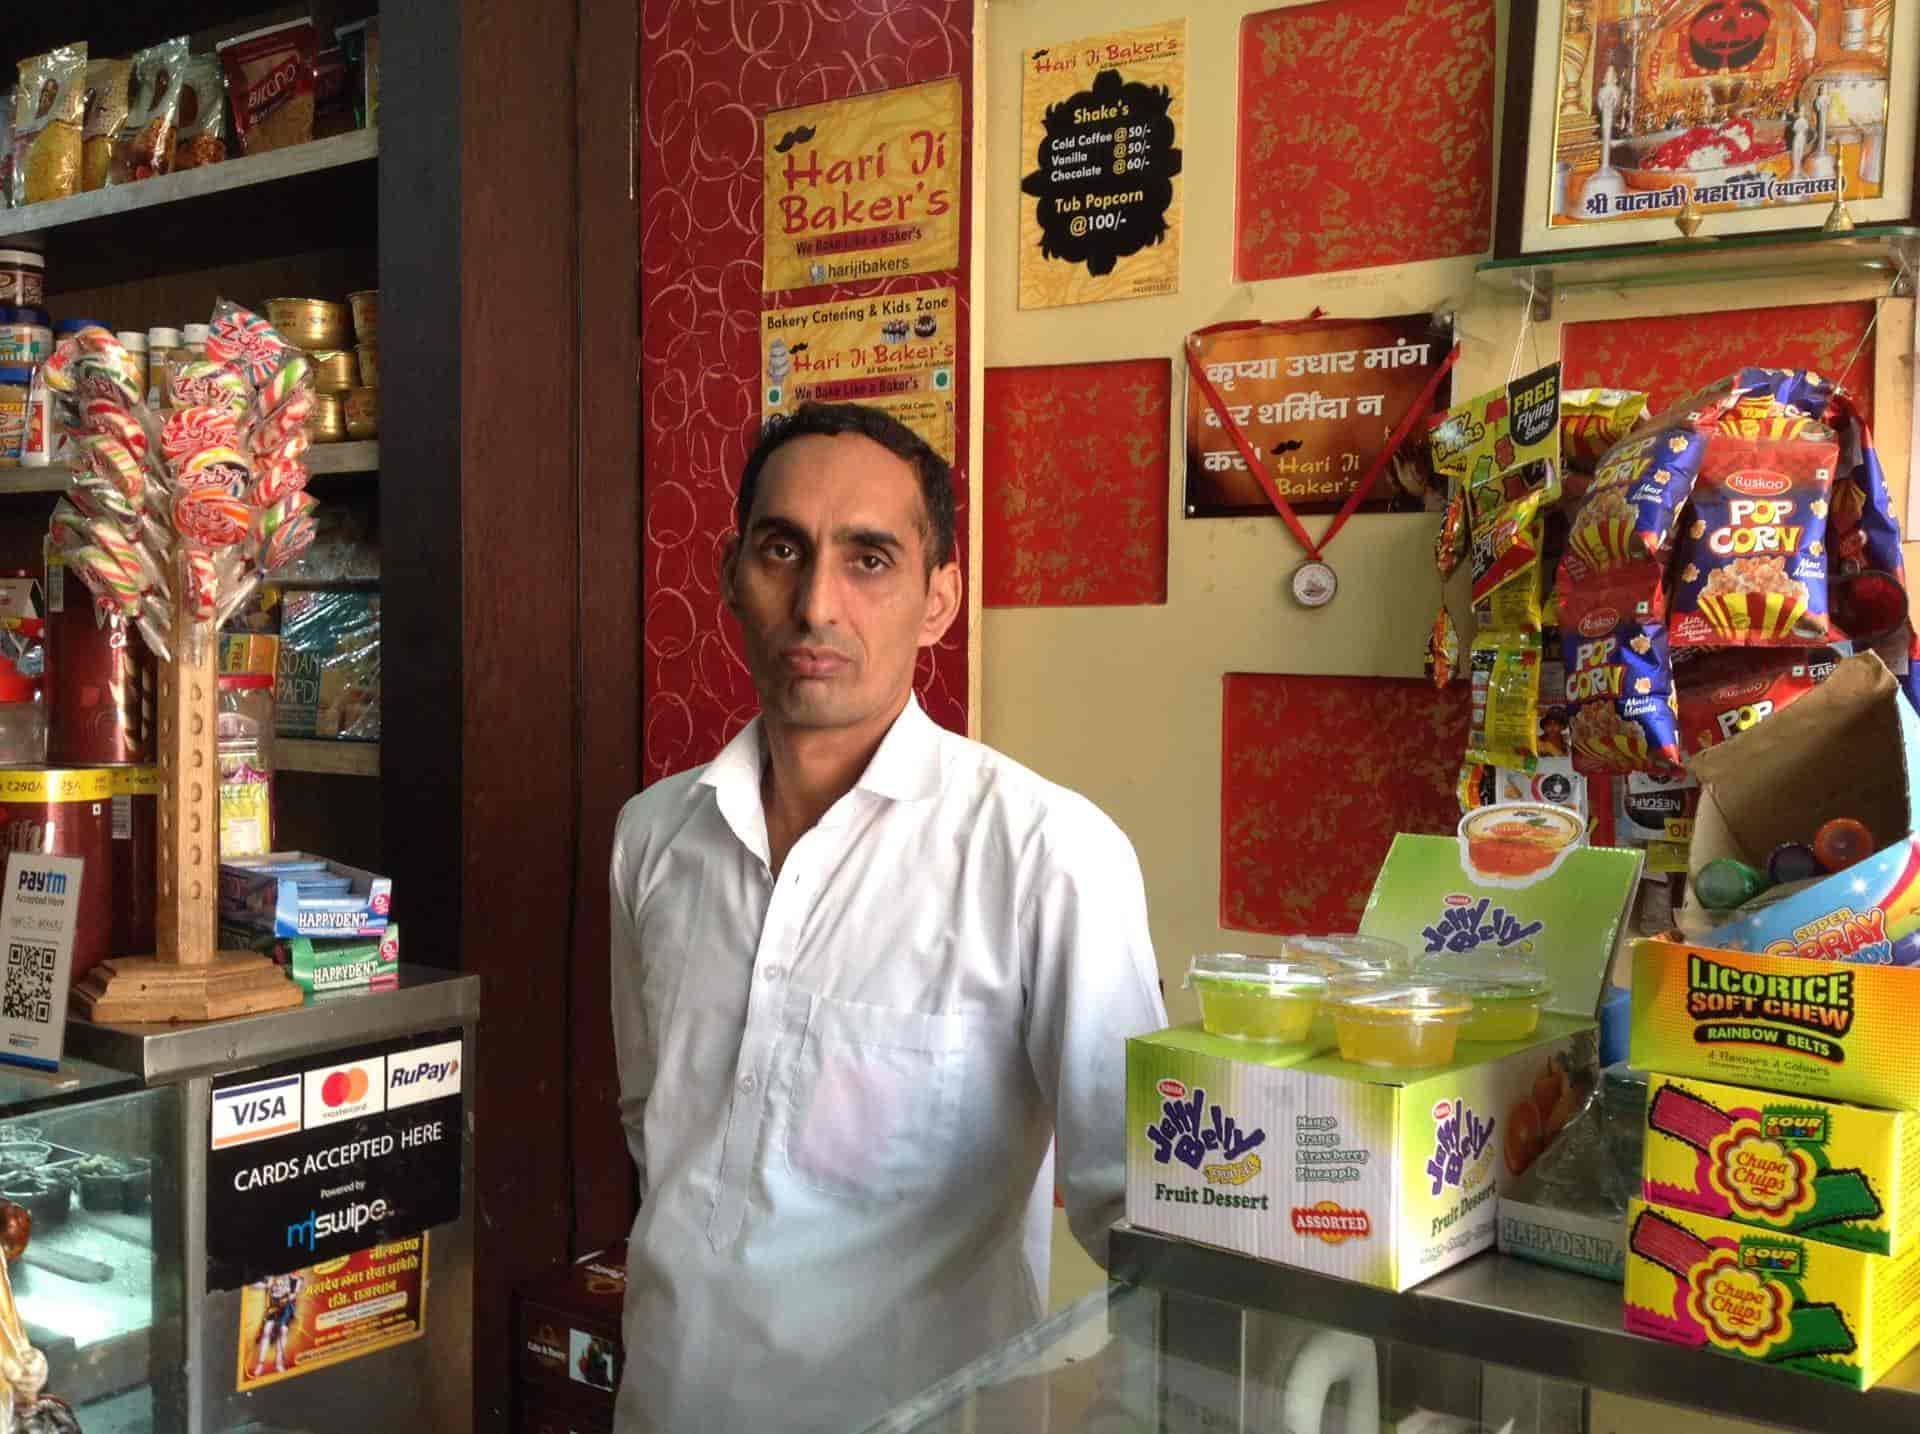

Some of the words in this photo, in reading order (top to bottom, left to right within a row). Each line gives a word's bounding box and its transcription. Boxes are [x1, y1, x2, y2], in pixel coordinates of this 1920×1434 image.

[1036, 56, 1077, 73] Hari
[1086, 49, 1100, 67] Ji
[1106, 35, 1177, 60] Baker's
[1073, 99, 1129, 124] Shake's
[1051, 136, 1075, 151] Cold
[1078, 131, 1112, 146] Coffee
[783, 142, 887, 190] Hari
[910, 130, 947, 175] Ji
[1051, 152, 1087, 166] Vanilla
[1051, 165, 1102, 182] Chocolate
[779, 181, 950, 234] Baker's
[1055, 195, 1081, 213] Tub
[1085, 190, 1144, 210] Popcorn
[1585, 193, 1610, 215] श्री
[828, 256, 910, 278] harijibakers
[767, 314, 809, 330] Bakery
[812, 307, 864, 325] Catering
[869, 303, 878, 317] &
[882, 299, 911, 315] Kids
[916, 296, 948, 312] Zone
[793, 352, 840, 373] Hari
[851, 348, 866, 368] Ji
[873, 340, 954, 364] Baker's
[1286, 349, 1359, 377] उधार
[1363, 338, 1431, 370] मांग
[1357, 395, 1385, 417] न
[1514, 376, 1556, 416] FREE
[1517, 399, 1554, 433] Flying
[1278, 455, 1330, 474] Hari
[1342, 453, 1359, 472] Ji
[1276, 477, 1360, 496] Baker's
[1730, 500, 1793, 525] POP
[1709, 526, 1800, 554] CORN
[1577, 637, 1616, 671] POP
[1566, 666, 1624, 701] CORN
[1717, 700, 1774, 739] POP
[298, 911, 368, 928] HAPPYDENT
[1796, 911, 1852, 940] SUPER
[313, 961, 378, 984] HAPPYDENT
[1691, 957, 1849, 1006] LICORICE
[1691, 992, 1758, 1012] SOFT
[1763, 999, 1849, 1031] CHEW
[1708, 1027, 1778, 1043] RAINBOW
[1786, 1034, 1830, 1057] BELTS
[232, 1095, 287, 1126] VISA
[390, 1060, 451, 1088] RuPay
[1766, 1115, 1823, 1128] SOUR
[234, 1158, 300, 1191] CARDS
[303, 1135, 393, 1175] ACCEPTED
[401, 1121, 442, 1149] HERE
[1736, 1151, 1789, 1174] Chupa
[321, 1182, 354, 1199] Powered
[355, 1180, 367, 1192] by
[1734, 1167, 1786, 1192] Chups
[1155, 1184, 1199, 1204] Fruit
[1202, 1187, 1268, 1210] Dessert
[1296, 1214, 1367, 1231] ASSORTED
[1432, 1206, 1459, 1237] Fruit
[1743, 1246, 1798, 1260] SOUR
[1713, 1279, 1764, 1304] Chupa
[1711, 1296, 1761, 1321] Chups
